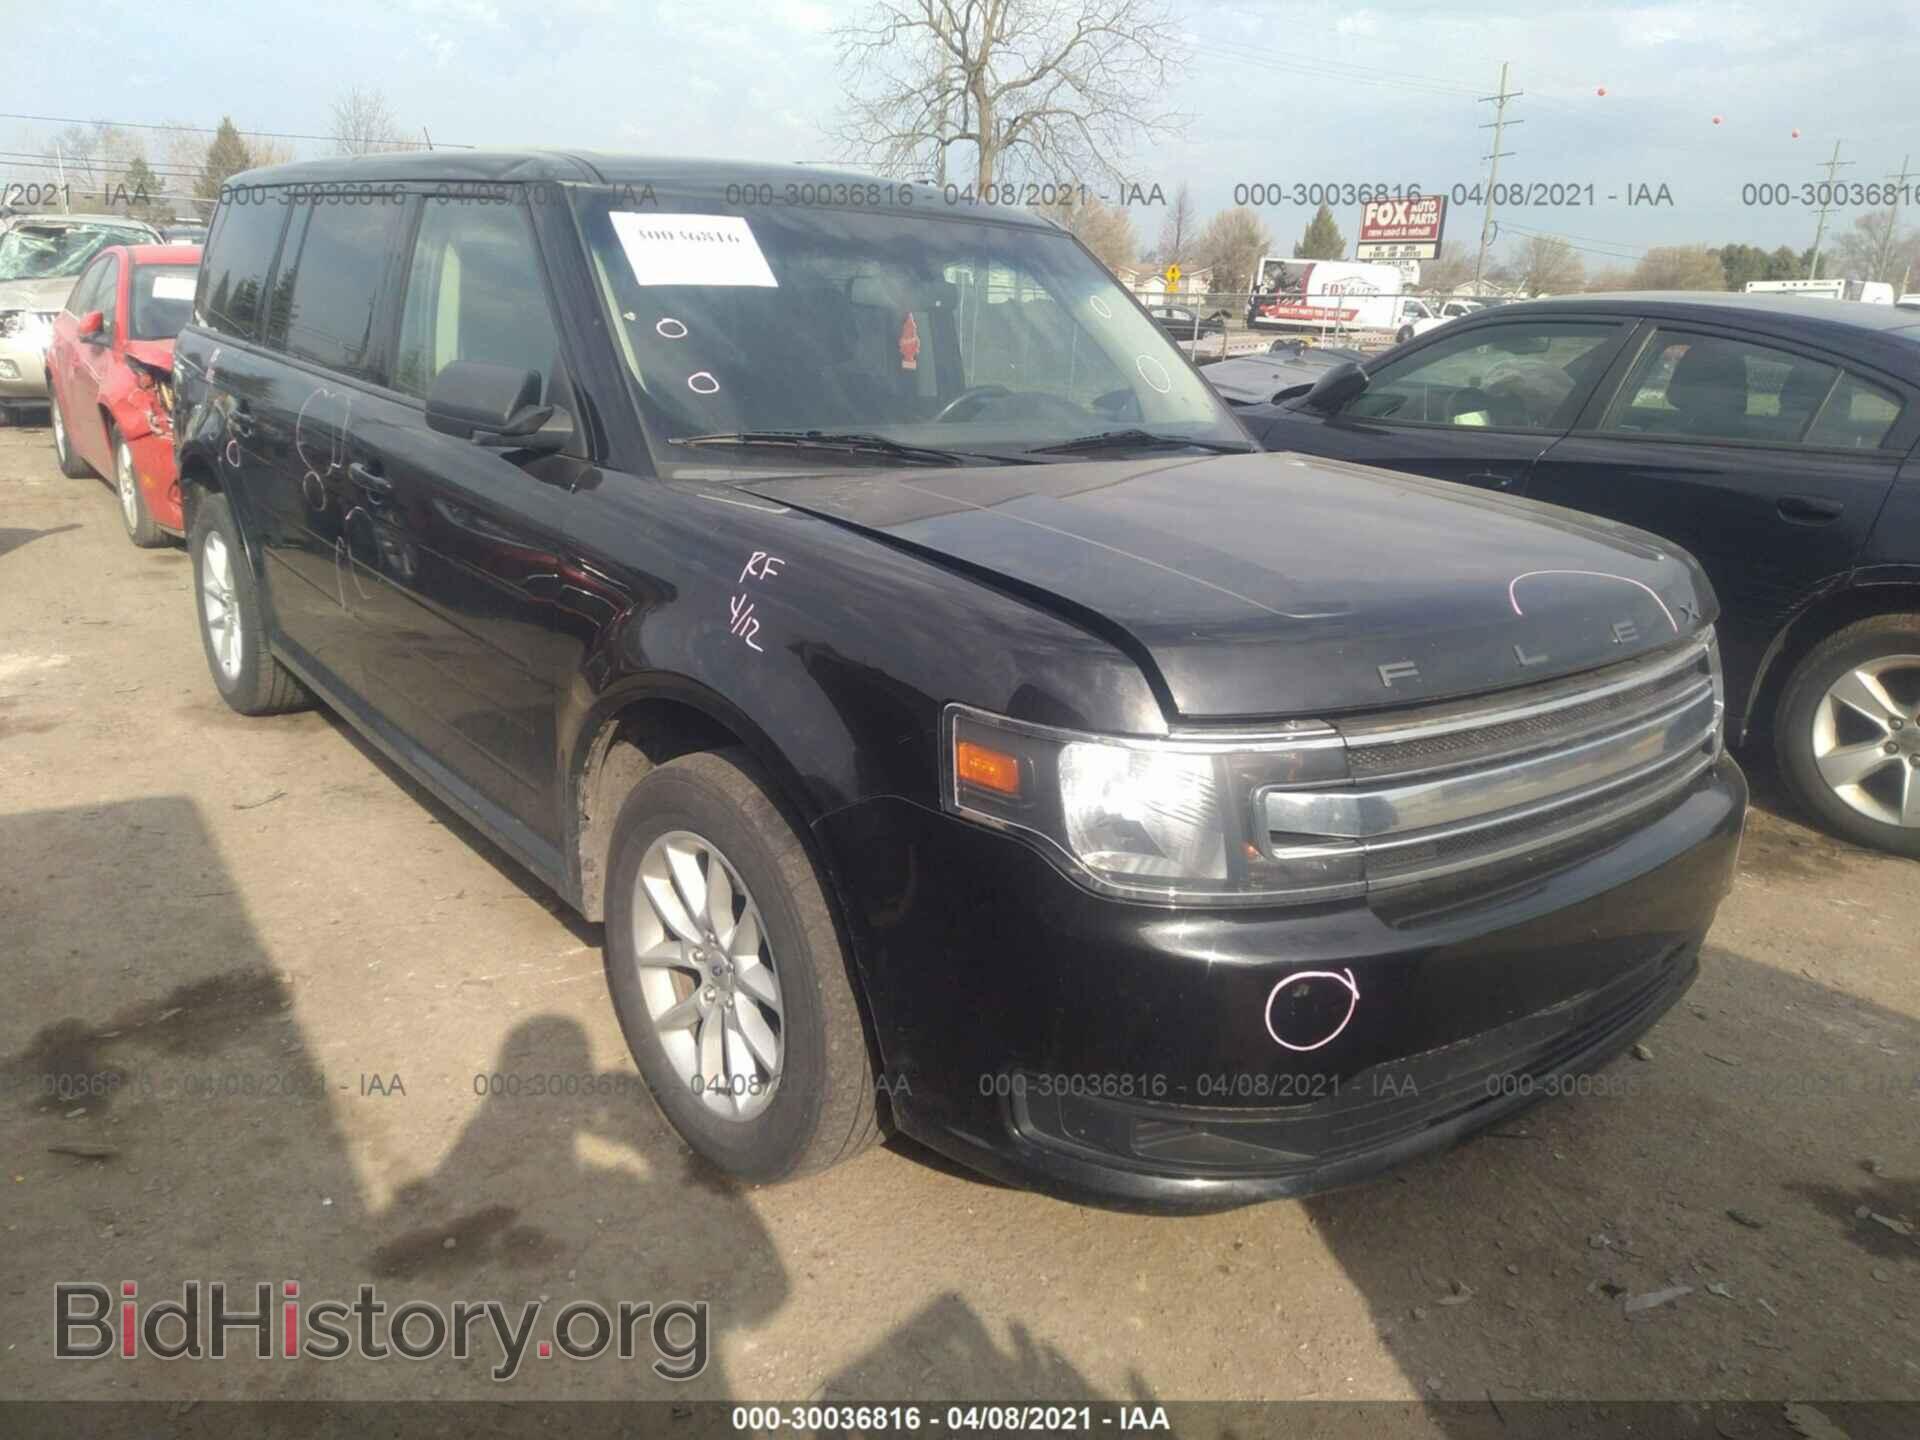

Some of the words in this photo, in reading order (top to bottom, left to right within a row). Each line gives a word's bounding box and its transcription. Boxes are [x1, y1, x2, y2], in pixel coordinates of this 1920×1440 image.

[1410, 200, 1437, 213] AUTO
[1364, 202, 1409, 226] FOX
[1408, 212, 1438, 225] PARTS
